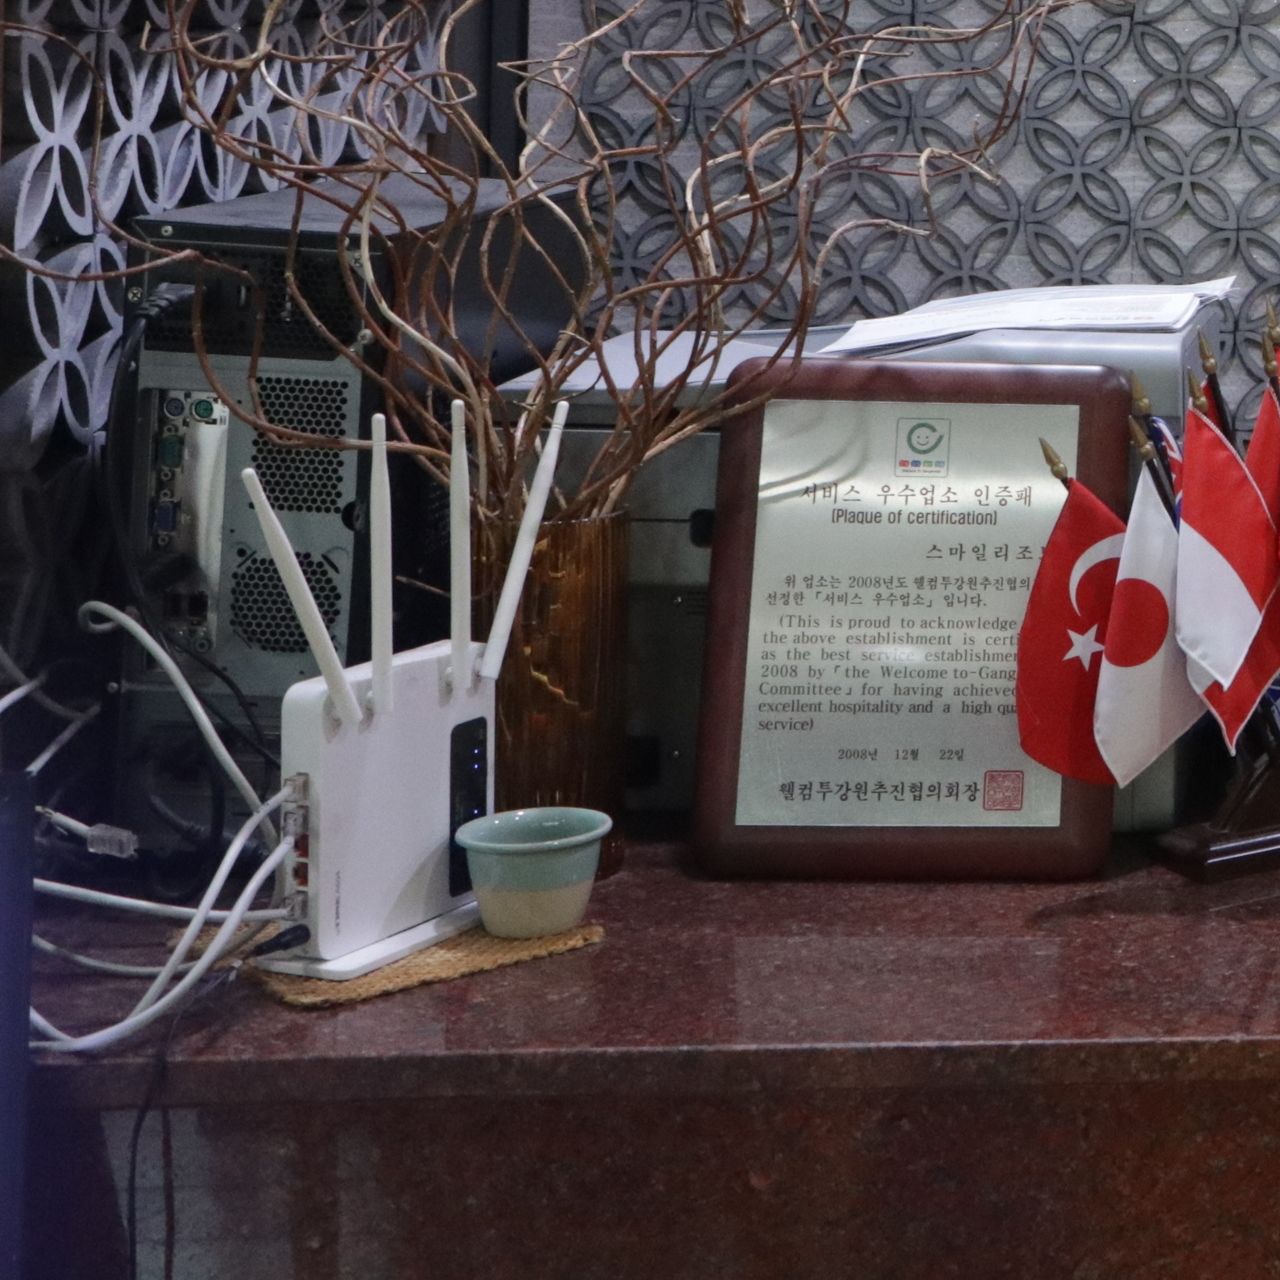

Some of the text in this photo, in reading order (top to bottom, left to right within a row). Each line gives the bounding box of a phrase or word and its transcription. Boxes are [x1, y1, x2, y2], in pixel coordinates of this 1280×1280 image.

[800, 483, 1033, 508] 서비스 우수업소 인증패
[888, 509, 902, 524] of
[907, 509, 998, 526] certification)
[784, 575, 796, 589] 위
[802, 575, 841, 590] 업소는
[848, 576, 911, 590] 2008년도
[765, 591, 805, 607] 선정한
[943, 592, 988, 608] 입니다.
[779, 614, 1017, 635] (This is proud to acknowledge
[763, 632, 788, 646] the
[792, 632, 836, 646] above
[845, 632, 952, 646] establishment
[962, 632, 976, 646] is
[761, 650, 776, 662] as
[786, 648, 812, 662] the
[820, 648, 851, 662] best
[860, 649, 916, 663] service
[760, 664, 799, 678] 2008
[807, 664, 825, 681] by
[880, 665, 948, 679] Welcome
[860, 682, 884, 696] for
[893, 682, 944, 699] having
[757, 699, 822, 714] excellent
[828, 699, 902, 716] hospitality
[908, 700, 933, 714] and
[942, 702, 951, 714] a
[961, 699, 992, 716] high
[757, 719, 814, 732] service)
[837, 748, 965, 761] 2008년 12월 22일
[778, 781, 980, 802] 웰컴투강원추진협의회장
